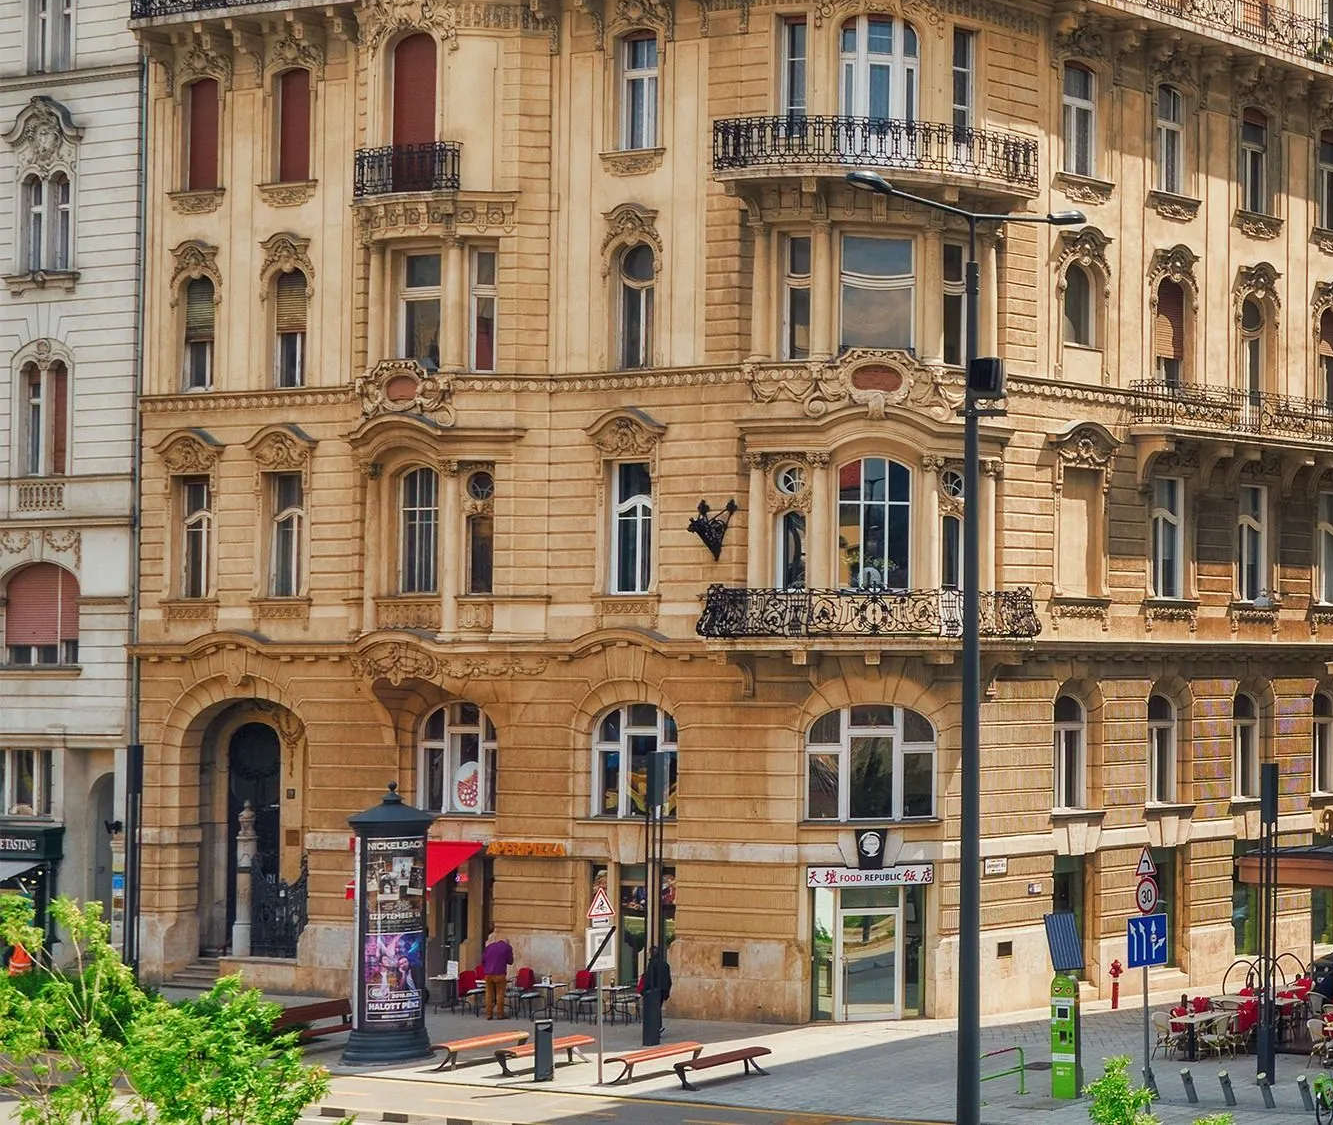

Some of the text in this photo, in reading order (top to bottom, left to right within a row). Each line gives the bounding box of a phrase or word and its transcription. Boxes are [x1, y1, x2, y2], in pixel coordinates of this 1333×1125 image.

[367, 840, 424, 851] NICKELBACK
[486, 842, 567, 856] APERIPIZZA
[840, 873, 901, 882] FOOD REPUBLIC
[1141, 888, 1153, 904] 30
[368, 1002, 401, 1011] HALOTT
